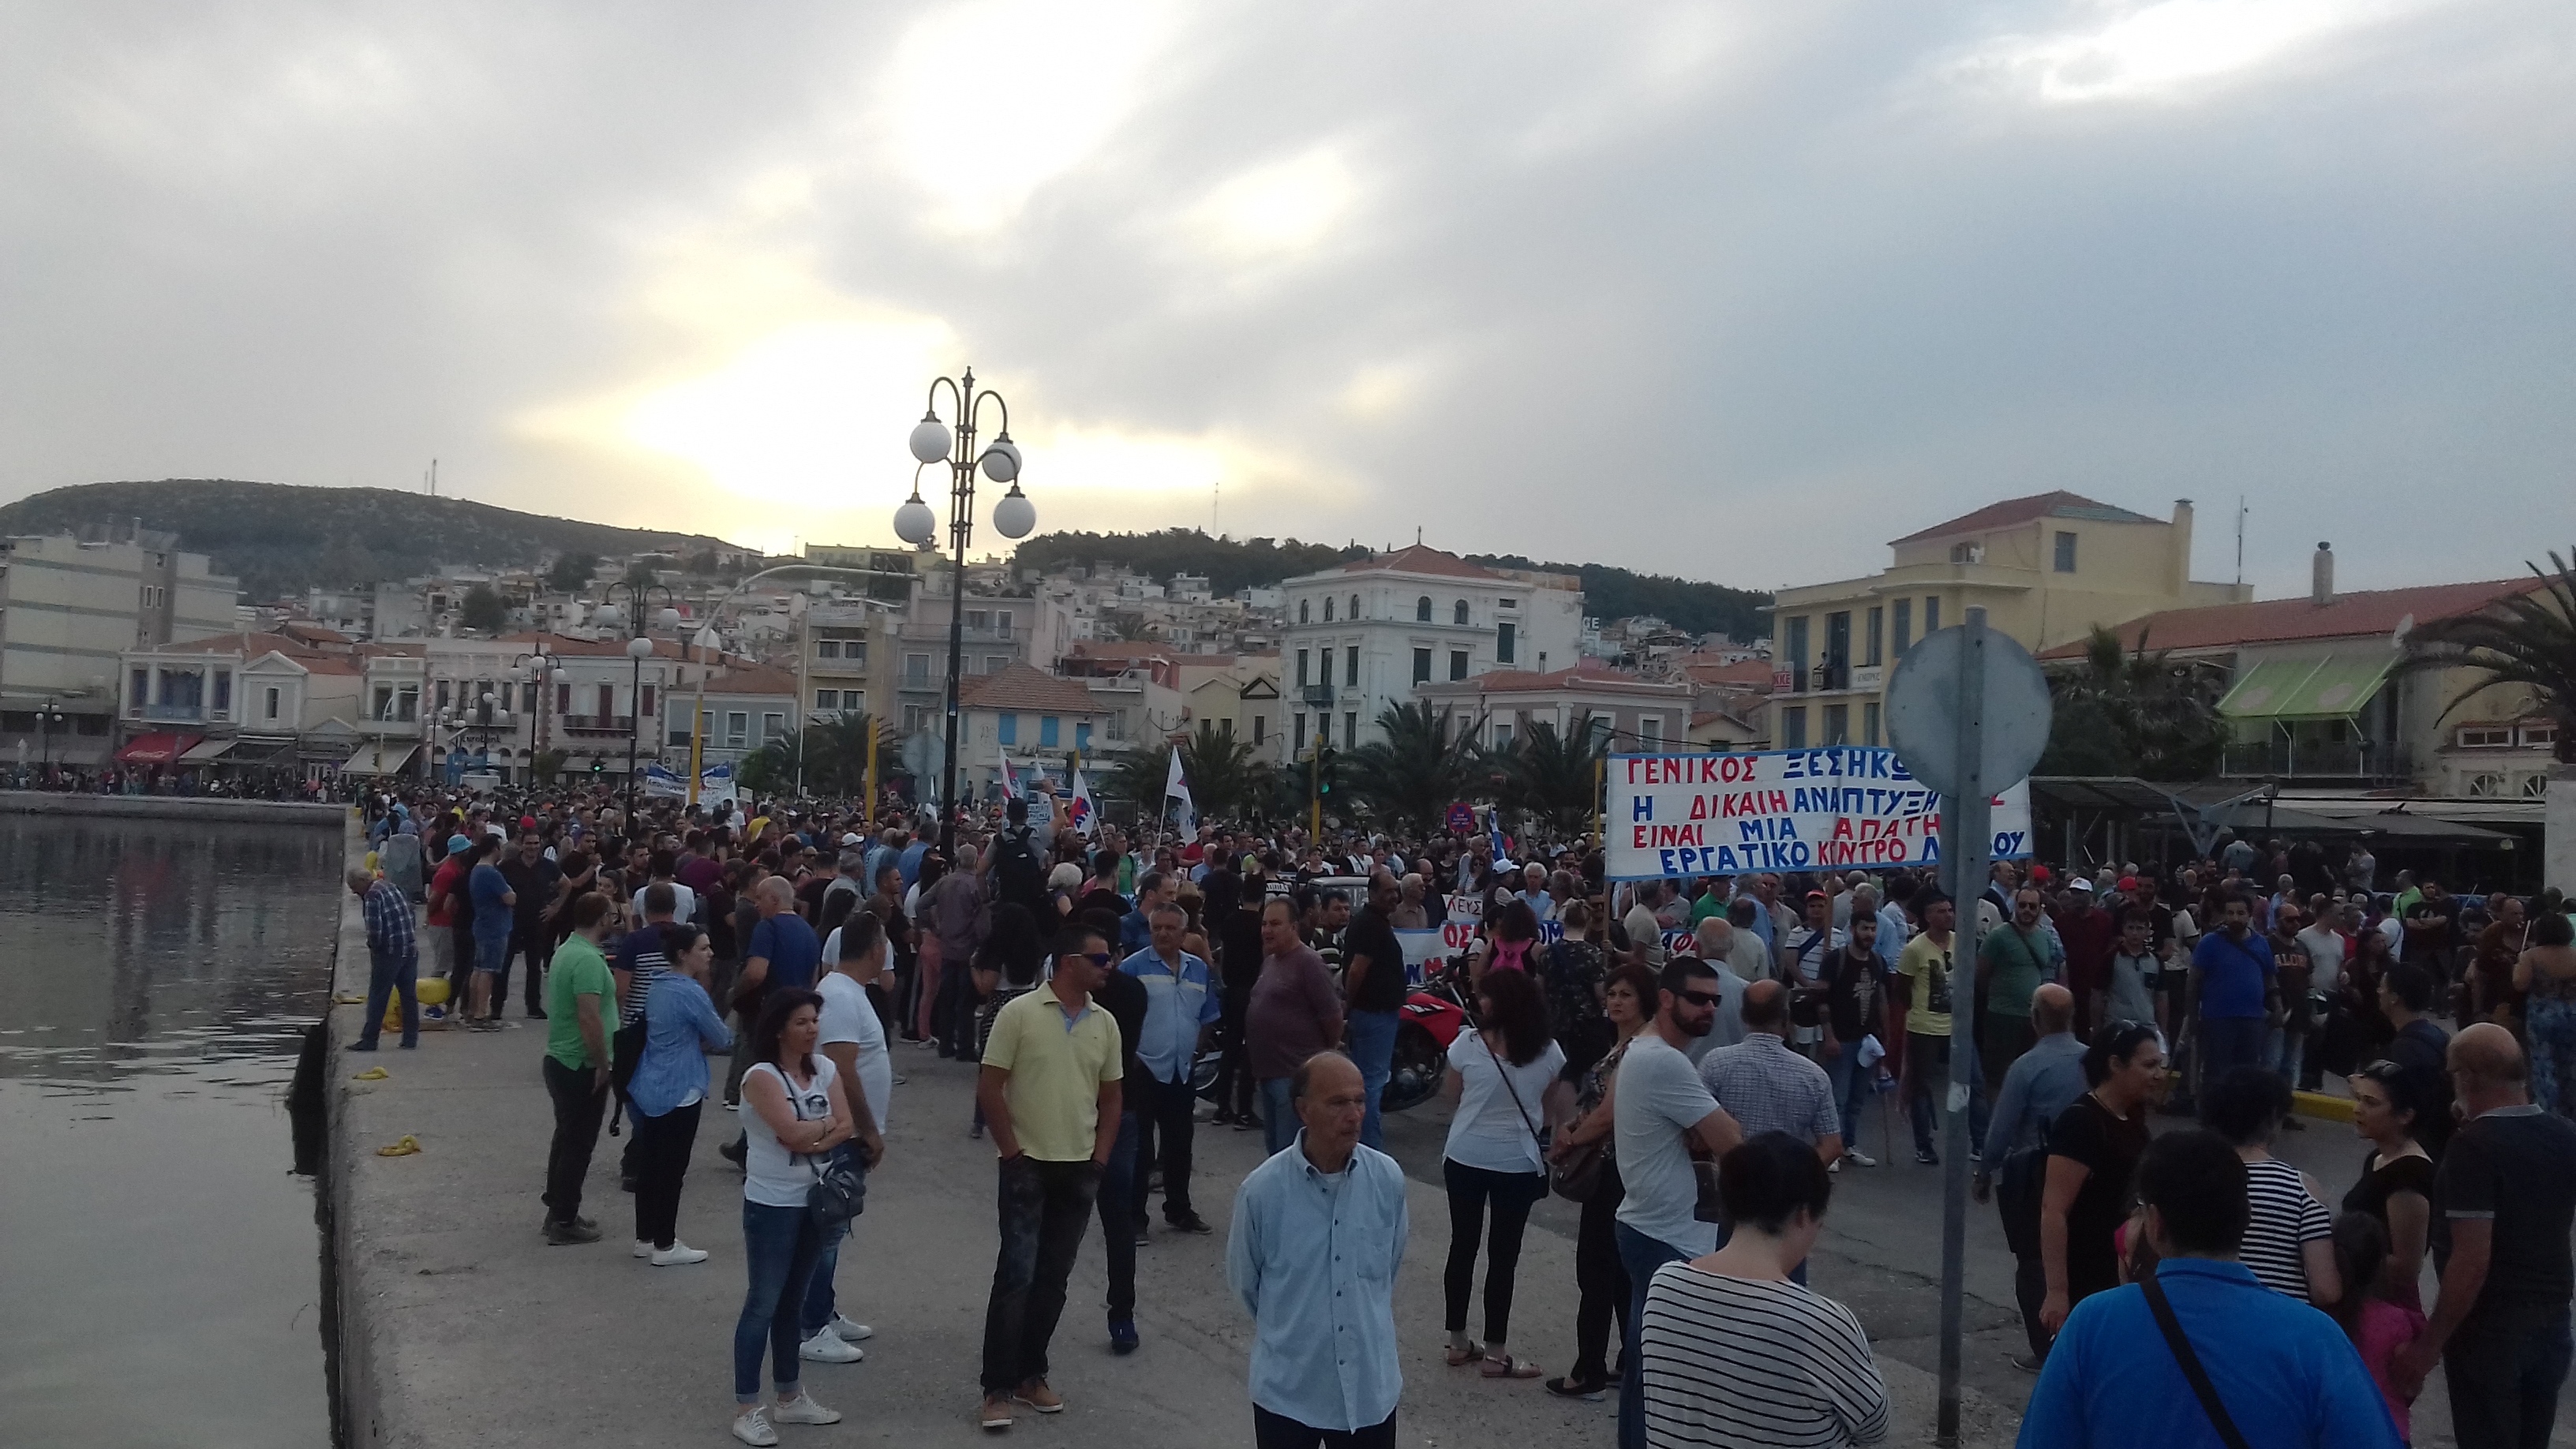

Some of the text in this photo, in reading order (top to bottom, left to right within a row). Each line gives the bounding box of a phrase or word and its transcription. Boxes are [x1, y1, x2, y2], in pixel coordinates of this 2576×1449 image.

[1627, 750, 1914, 784] ΓΕΝΙΚΟΣ ΞΕΣΗΚΩ
[1633, 787, 1939, 822] Η ΔΙΚΑΙΗ ΑΝΑΠΤΥΞΗ
[1633, 813, 1941, 848] ΕΙΝΑΙ ΜΙΑ ΑΠΑΤΗ
[1660, 841, 1810, 874] ΕΡΓΑΤΙΚΟ
[1921, 831, 2025, 862] ΛΟΥ
